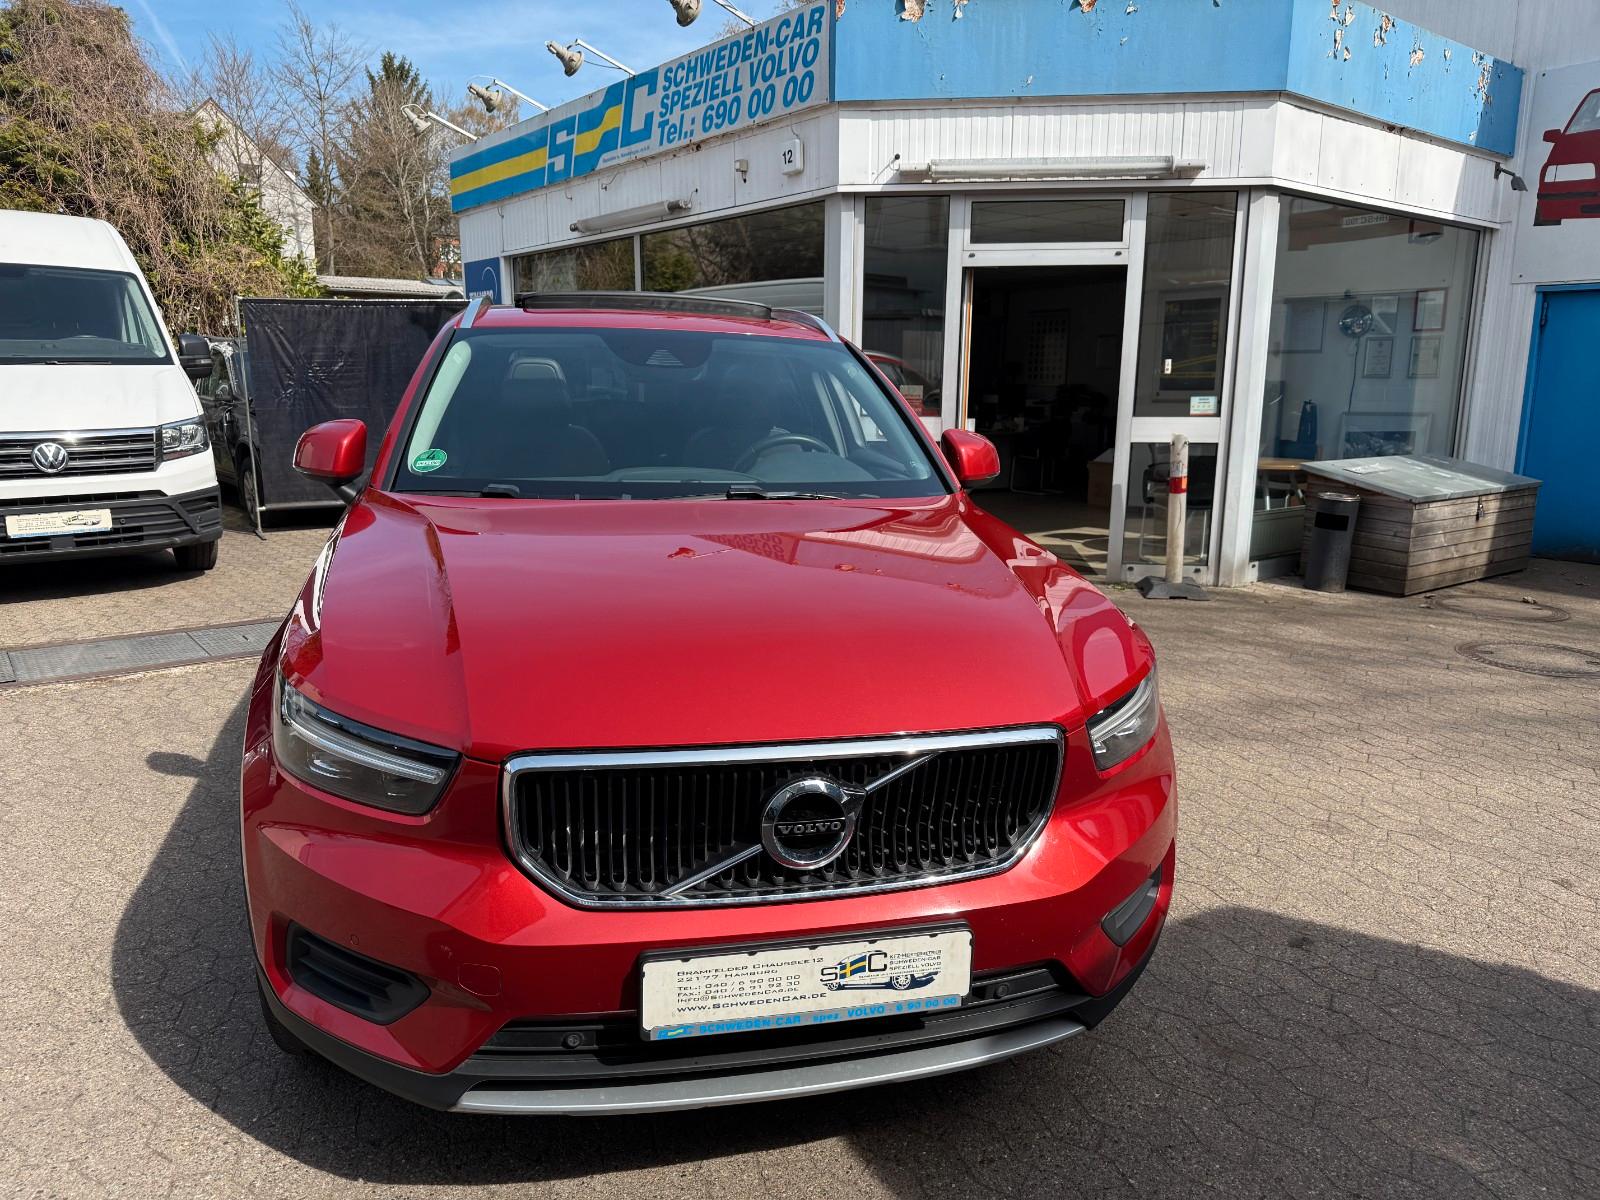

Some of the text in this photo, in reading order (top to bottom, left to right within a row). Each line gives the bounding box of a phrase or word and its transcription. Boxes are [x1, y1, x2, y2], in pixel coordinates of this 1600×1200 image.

[663, 5, 826, 92] SCHWEDEN-CAR
[659, 38, 820, 118] SPEZIELL VOLVO
[658, 70, 815, 146] Tel.: 690 00 00
[782, 149, 793, 165] 12
[778, 821, 841, 835] VOLVO
[676, 992, 828, 1012] WWW.SCHWEDENCAR.DE
[847, 1005, 885, 1017] VOLVO
